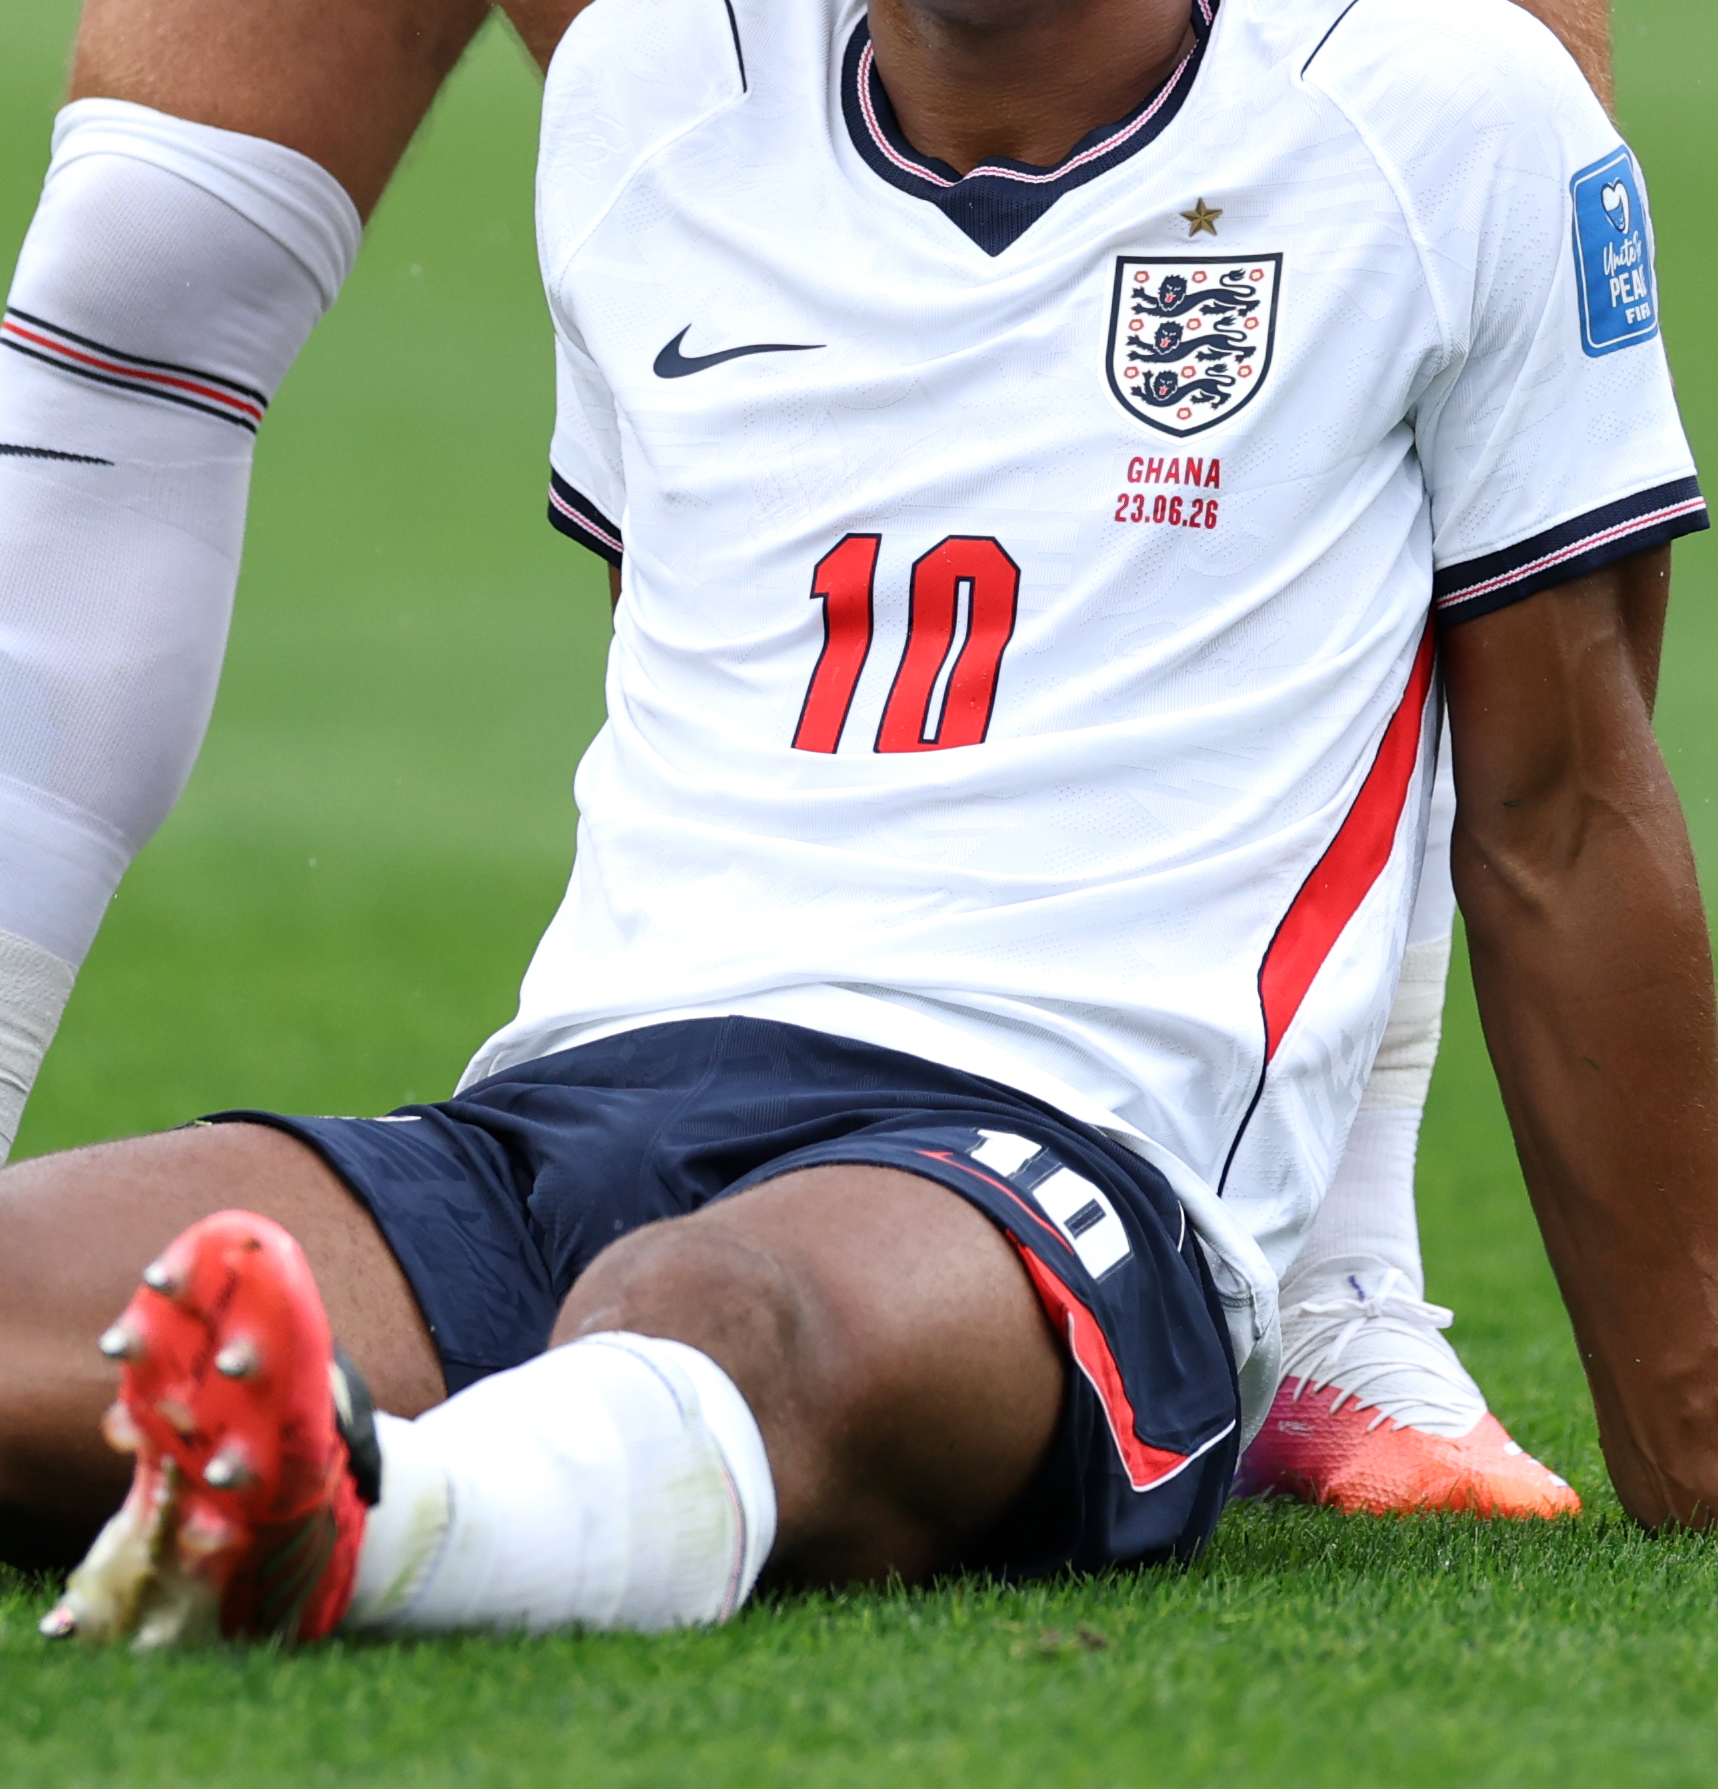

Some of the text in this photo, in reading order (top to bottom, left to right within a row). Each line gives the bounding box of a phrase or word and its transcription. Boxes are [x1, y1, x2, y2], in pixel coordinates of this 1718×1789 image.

[1127, 457, 1220, 489] GHANA
[1114, 493, 1219, 529] 23.06.26
[791, 532, 1021, 754] 10
